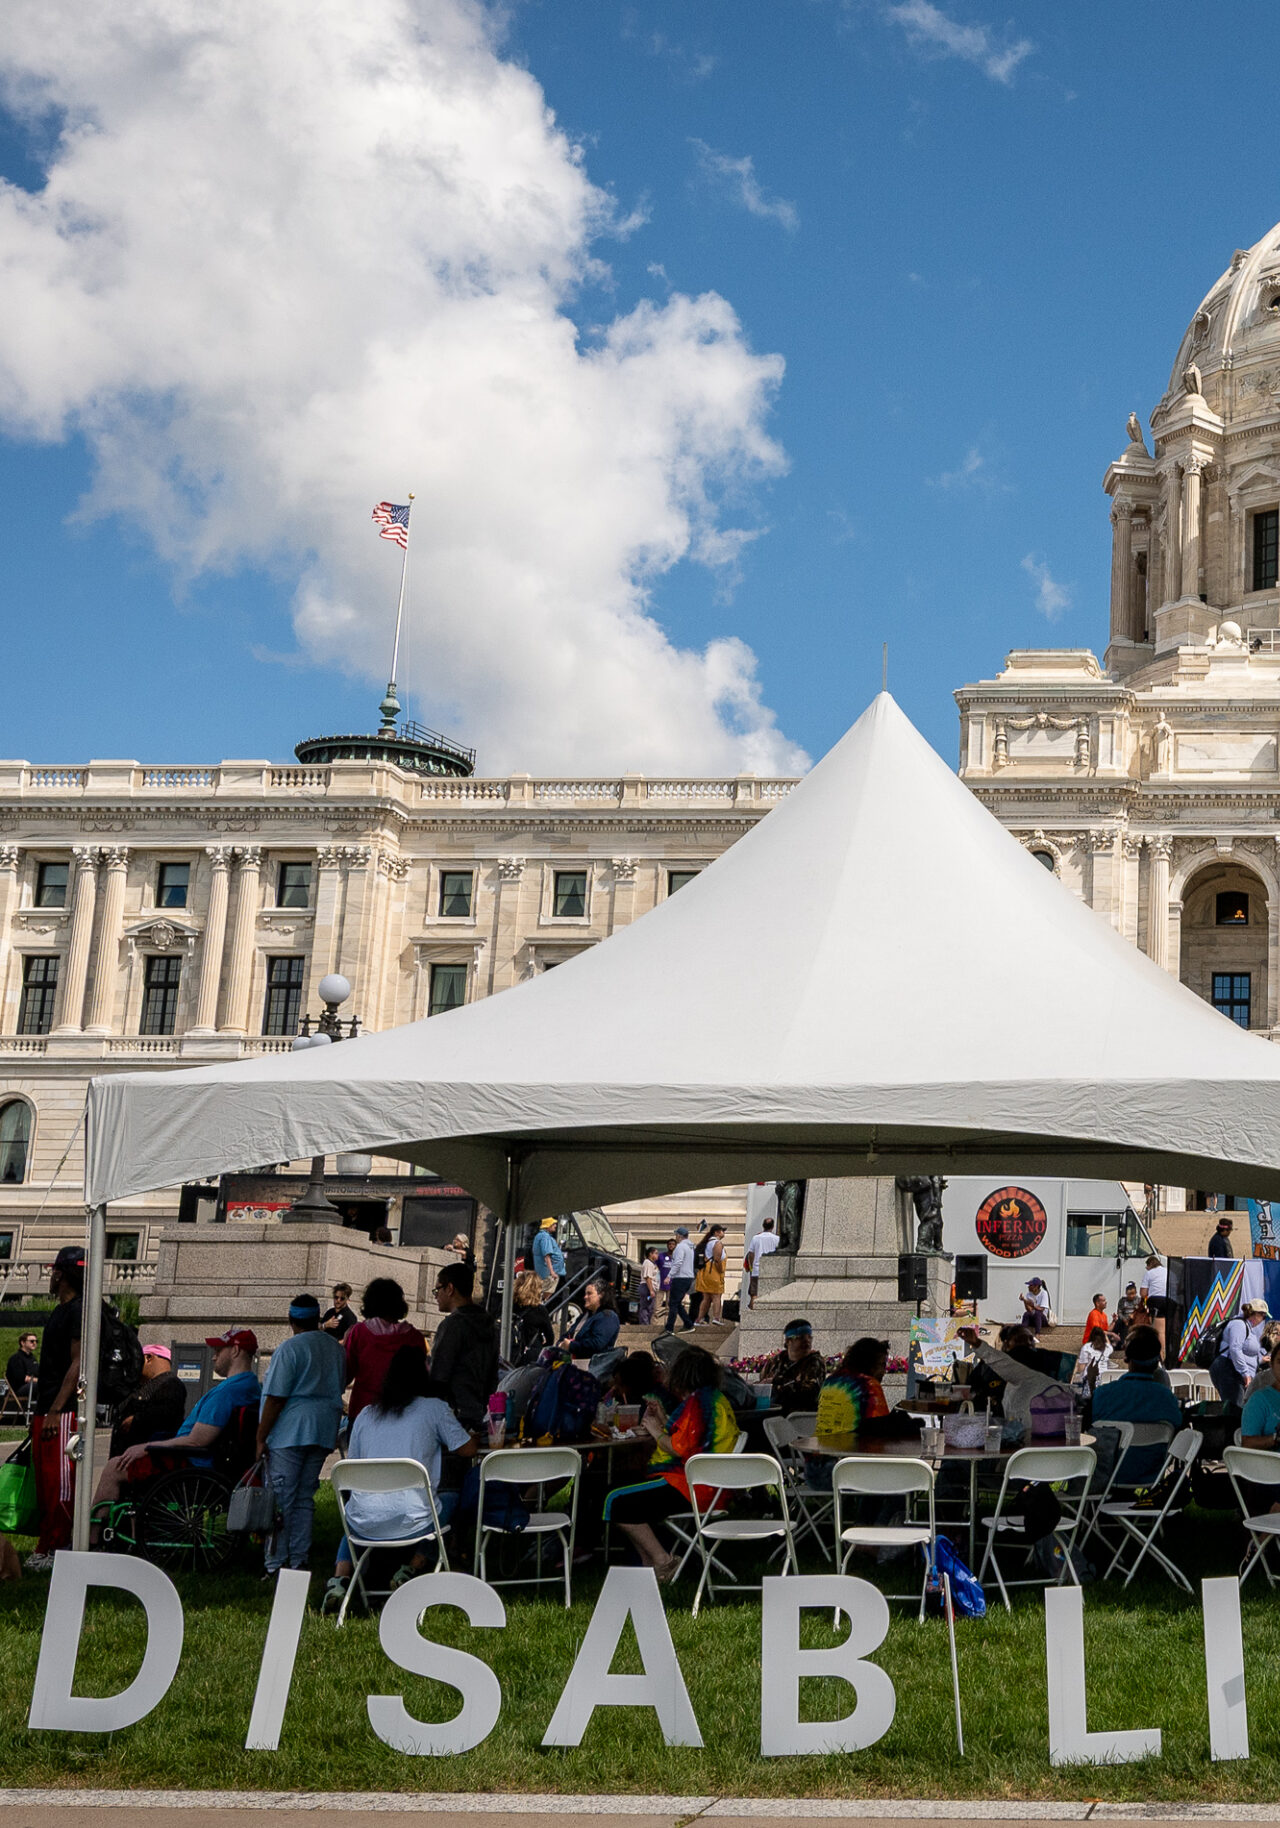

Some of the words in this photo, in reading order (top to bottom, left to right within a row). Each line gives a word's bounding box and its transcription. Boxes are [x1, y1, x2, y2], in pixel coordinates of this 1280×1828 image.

[977, 1220, 1046, 1233] INFERNO
[981, 1234, 1012, 1258] WOOD
[1013, 1234, 1042, 1258] FIRED
